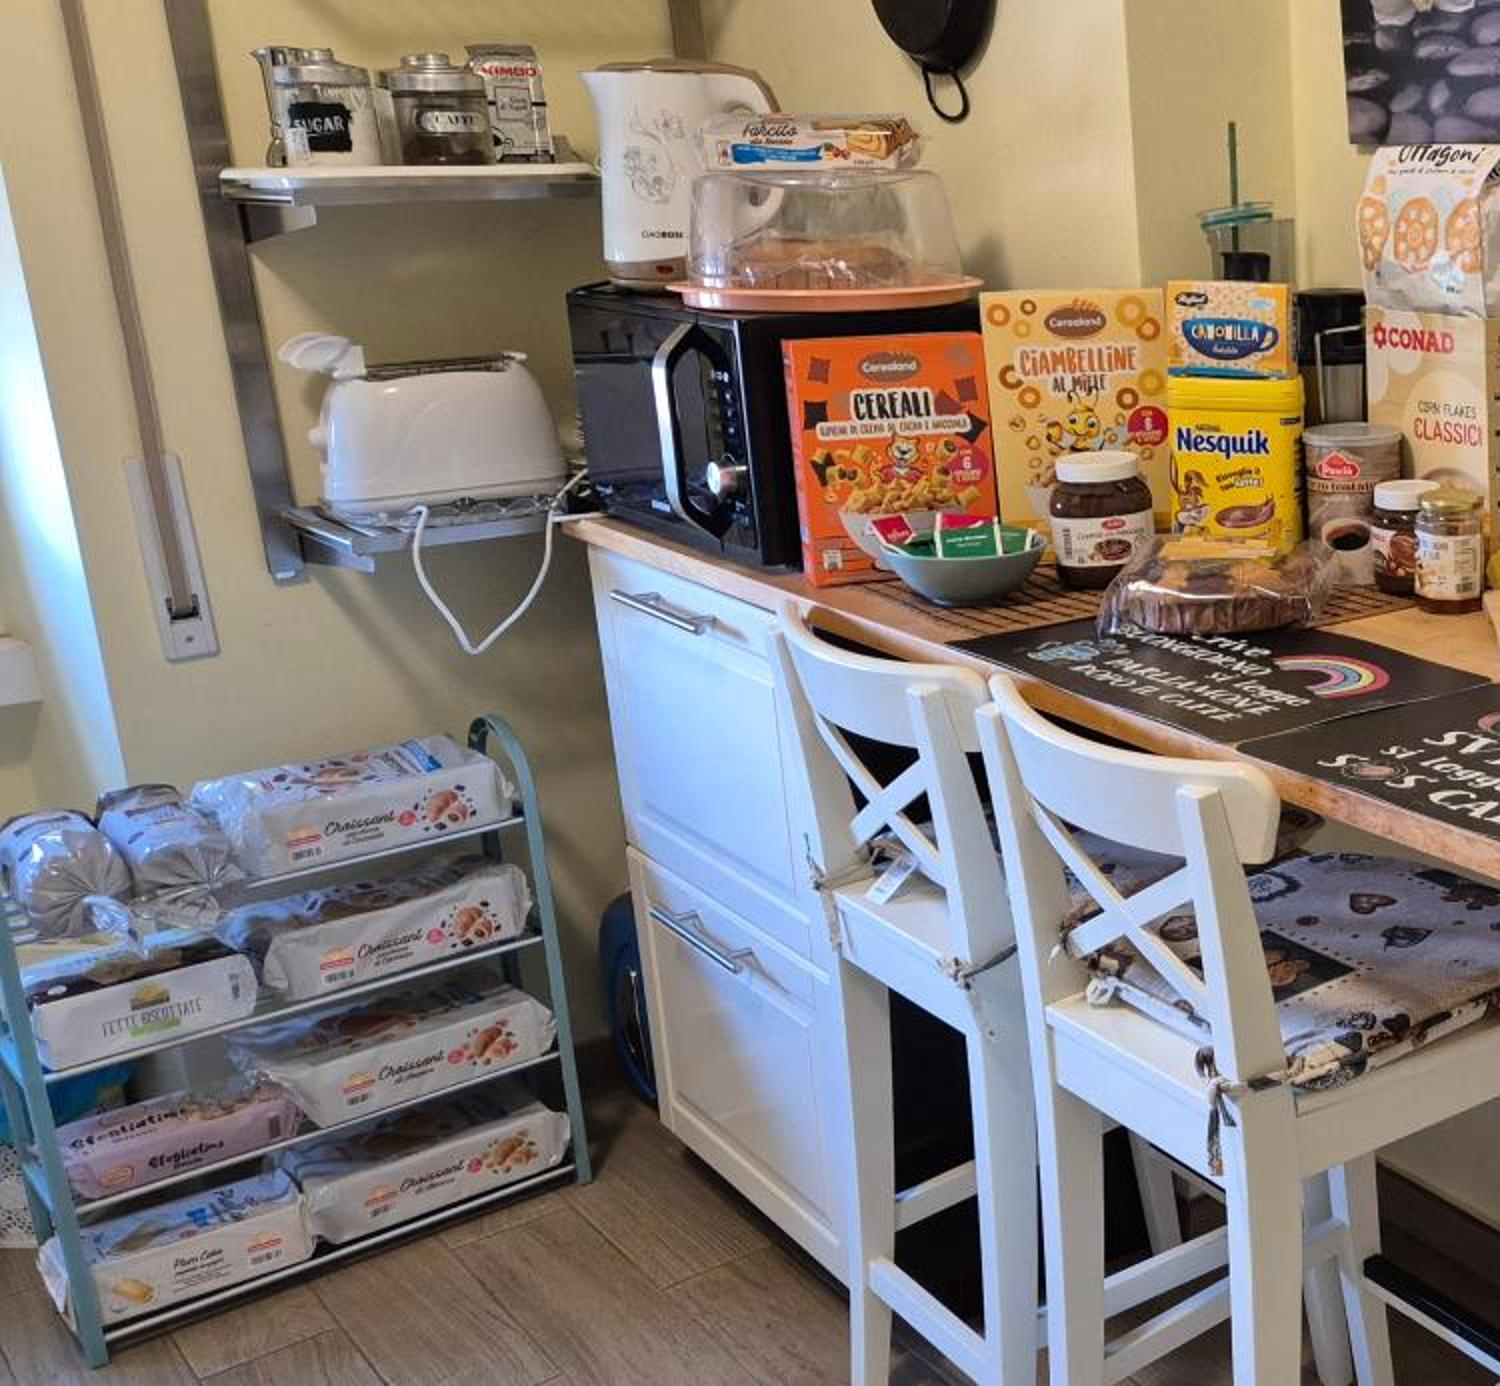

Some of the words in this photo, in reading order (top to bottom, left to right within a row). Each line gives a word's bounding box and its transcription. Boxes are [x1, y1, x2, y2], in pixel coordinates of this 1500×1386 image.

[294, 116, 344, 133] SUGAR
[1389, 328, 1455, 354] CONAD
[1054, 377, 1066, 393] AL
[854, 390, 931, 421] CEREALI
[1177, 427, 1269, 460] Nesquik
[1380, 745, 1425, 760] si
[323, 811, 394, 837] Croissant
[357, 928, 423, 958] Croissant
[379, 1050, 443, 1081] Croissant
[401, 1160, 464, 1191] Croissant
